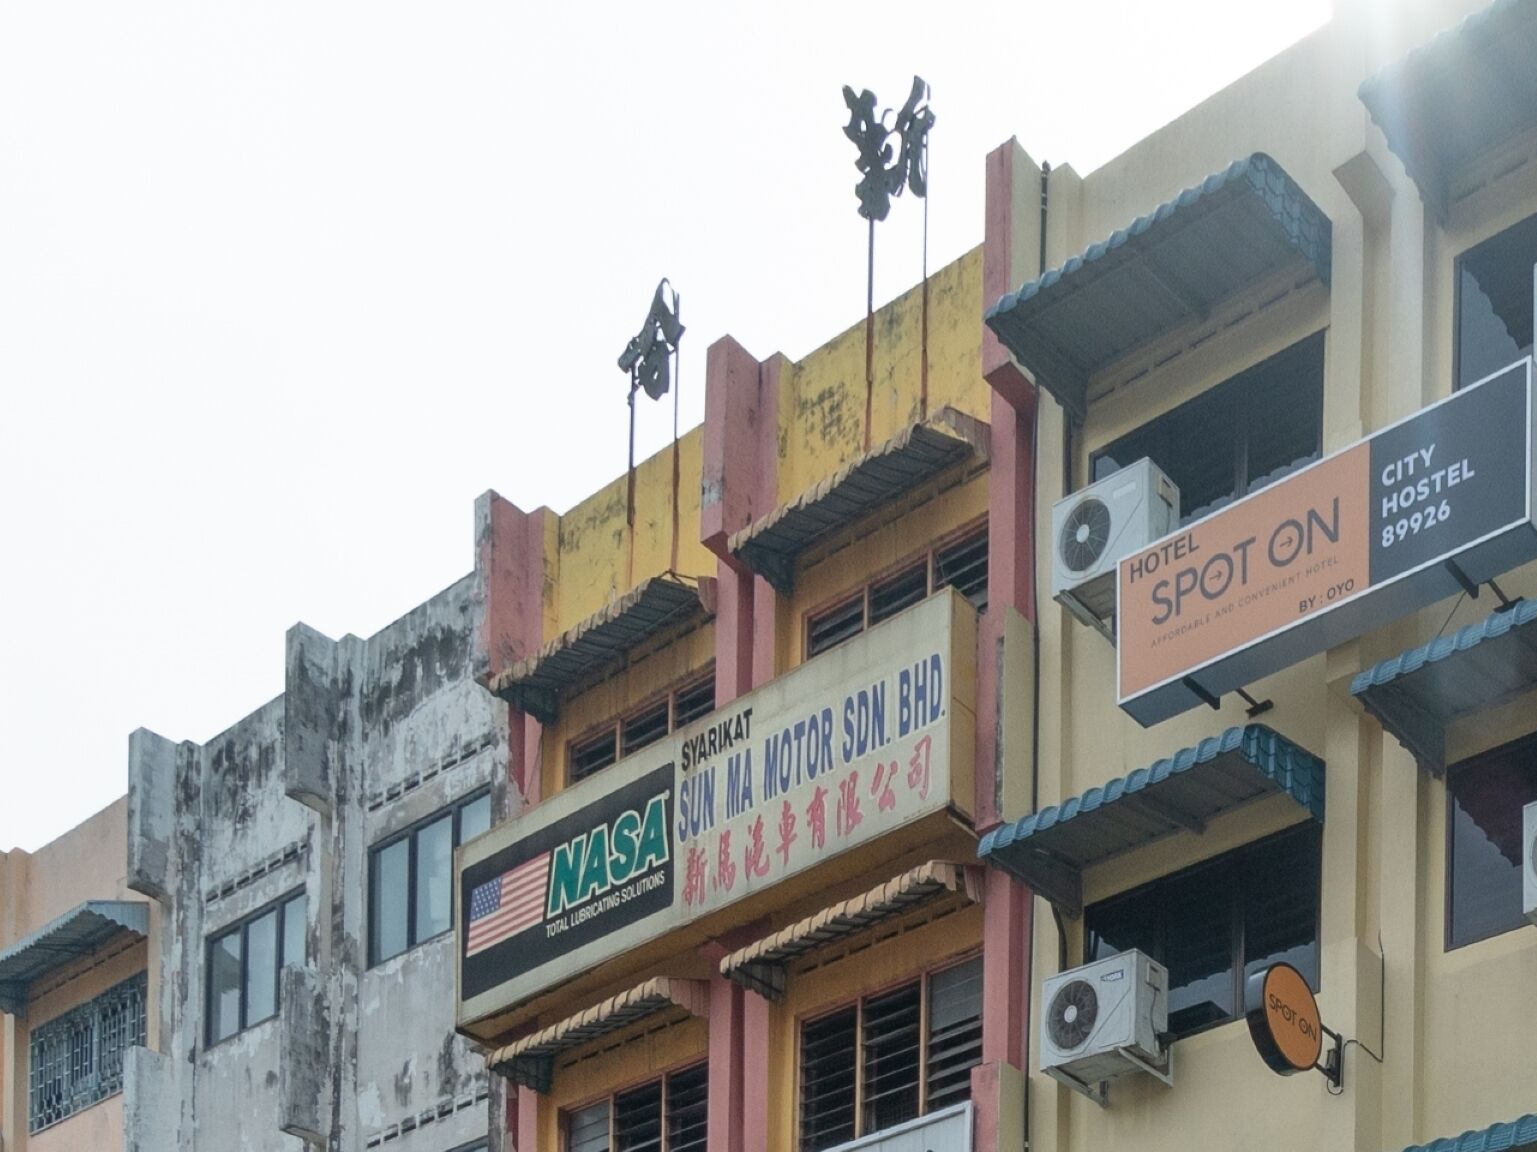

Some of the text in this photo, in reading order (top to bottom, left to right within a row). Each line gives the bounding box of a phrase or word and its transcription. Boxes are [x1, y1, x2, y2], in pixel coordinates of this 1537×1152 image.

[1381, 443, 1436, 487] CITY
[1381, 458, 1475, 518] HOSTEL
[1381, 500, 1451, 548] 89926
[1129, 533, 1200, 584] HOTEL
[1151, 497, 1339, 626] SPOT ON
[1151, 556, 1339, 649] AFFORDABLE AND CONVENIENT HOTEL
[1299, 578, 1355, 614] BY OYO
[678, 653, 946, 843] SUN MA MOTOR SDN. BHD.
[681, 708, 753, 772] SYARIKAT
[547, 794, 670, 920] NASA
[546, 870, 665, 938] TOTAL LUBRICATING SOLUTIONS
[1269, 993, 1317, 1043] SPOT ON
